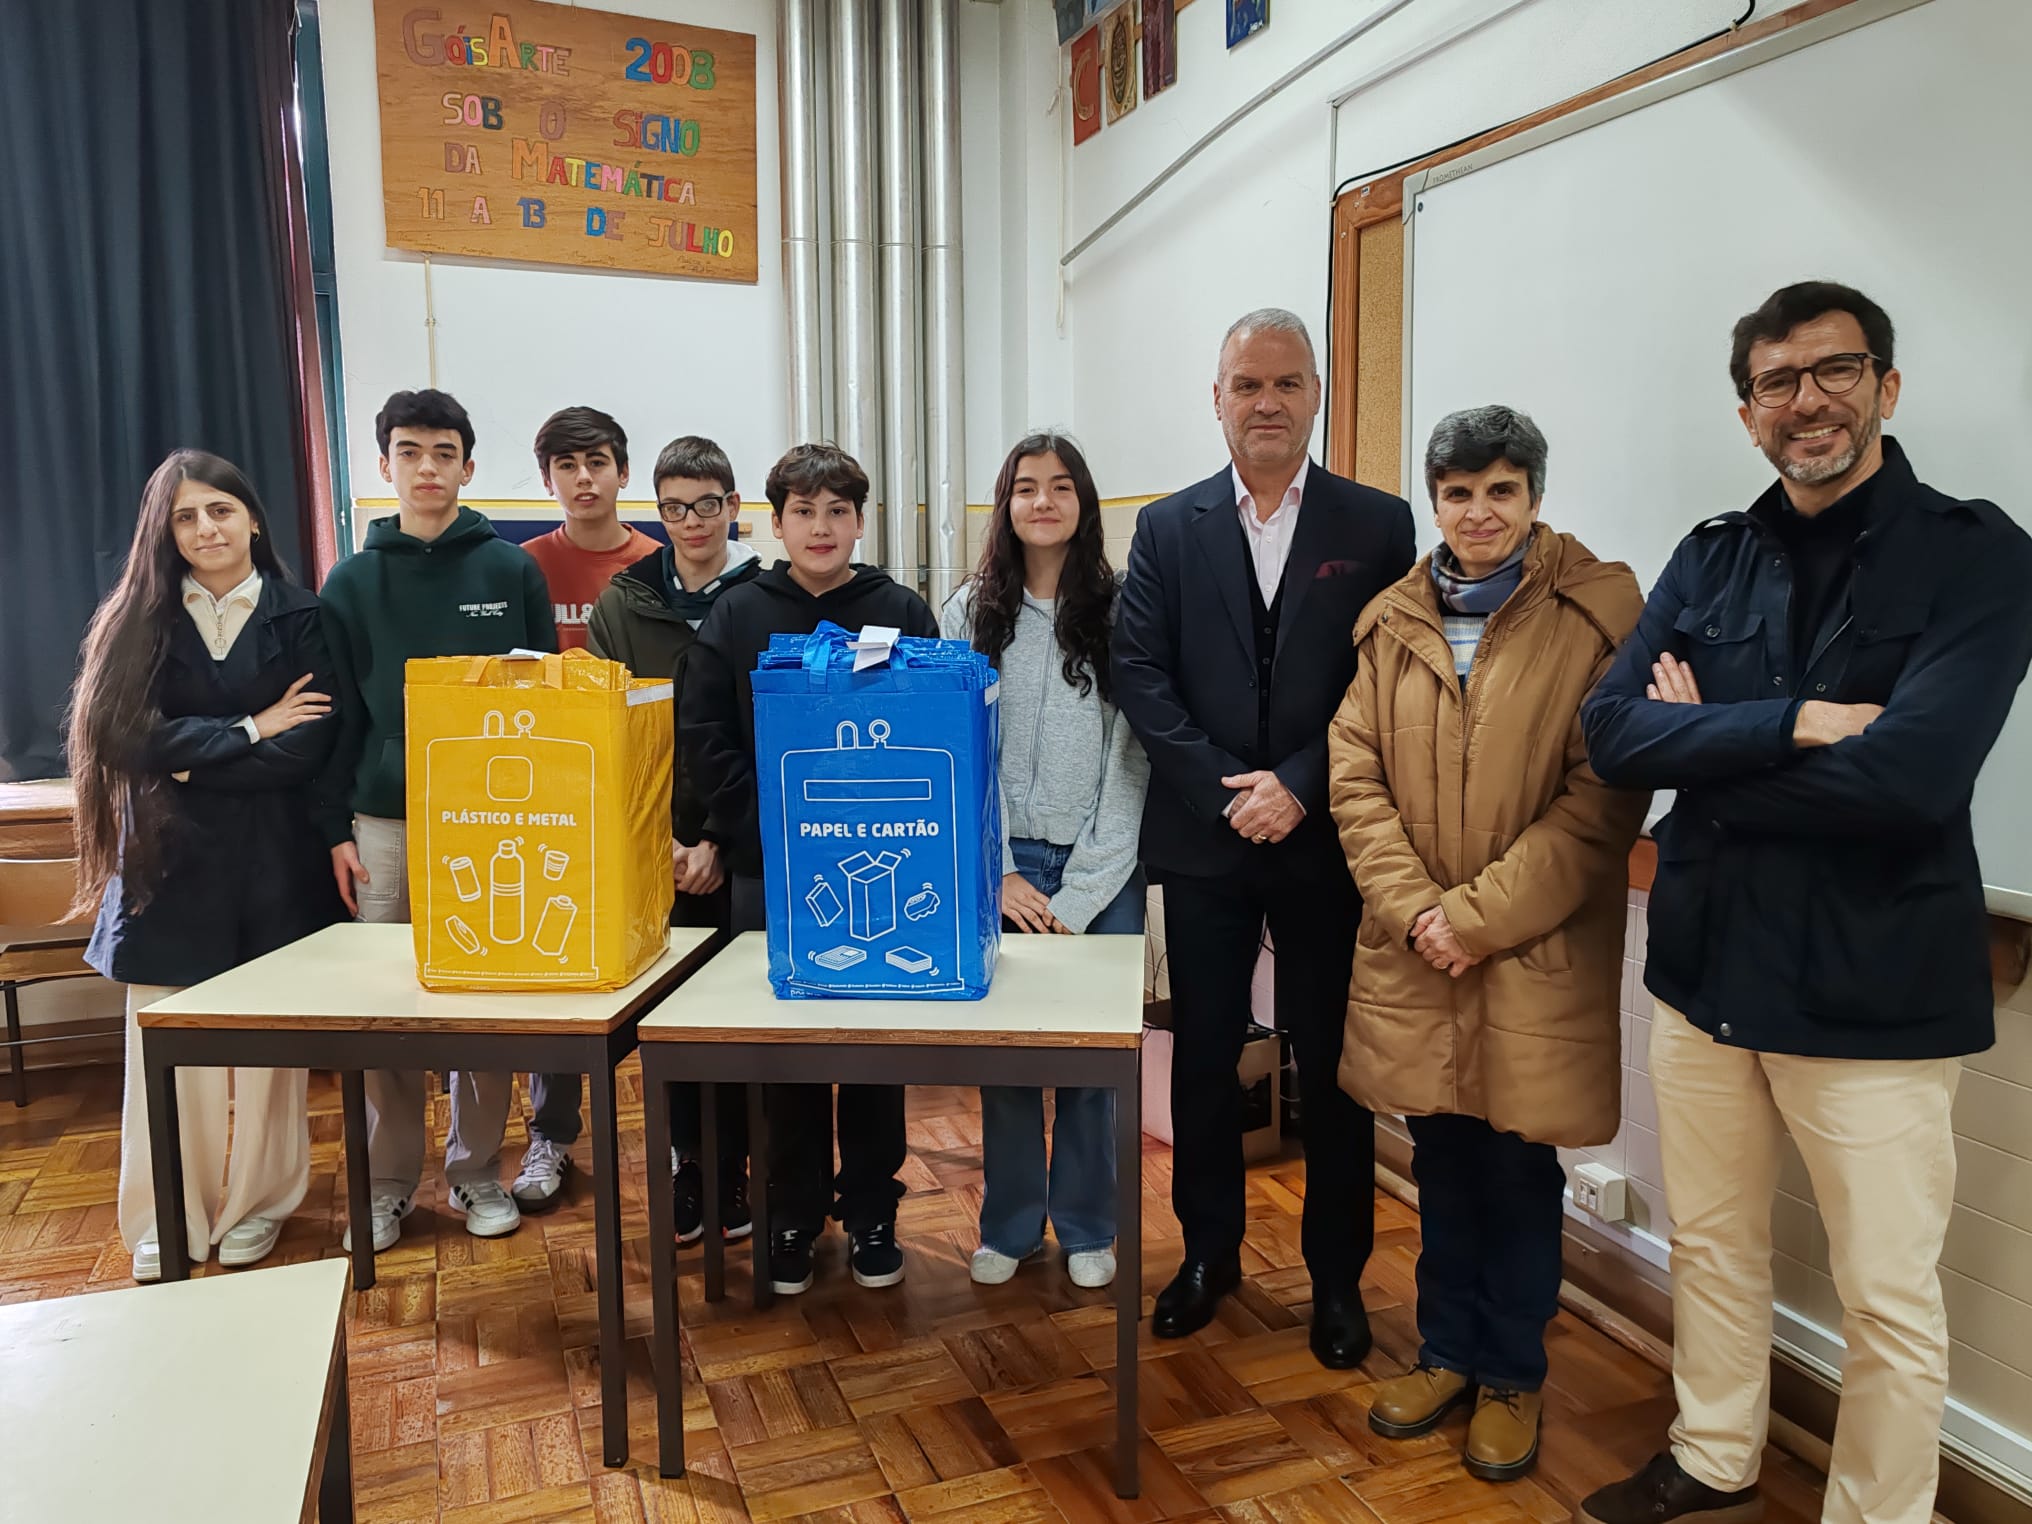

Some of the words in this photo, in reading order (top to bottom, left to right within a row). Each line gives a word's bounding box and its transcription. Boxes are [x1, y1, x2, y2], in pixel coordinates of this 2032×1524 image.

[625, 37, 716, 90] 2008
[441, 92, 503, 131] SOB
[539, 100, 567, 140] O
[613, 109, 700, 157] SIGNO
[444, 142, 482, 175] DA
[511, 137, 696, 206] MATEMÁTICA
[416, 186, 445, 220] 11
[470, 195, 492, 224] A
[516, 197, 547, 229] 13
[586, 206, 625, 241] DE
[648, 216, 735, 258] JULHO
[441, 808, 511, 825] PLÁSTICO
[515, 812, 524, 826] E
[528, 812, 577, 827] METAL
[800, 822, 852, 838] PAPEL
[856, 823, 867, 838] E
[871, 818, 939, 838] CARTÃO
